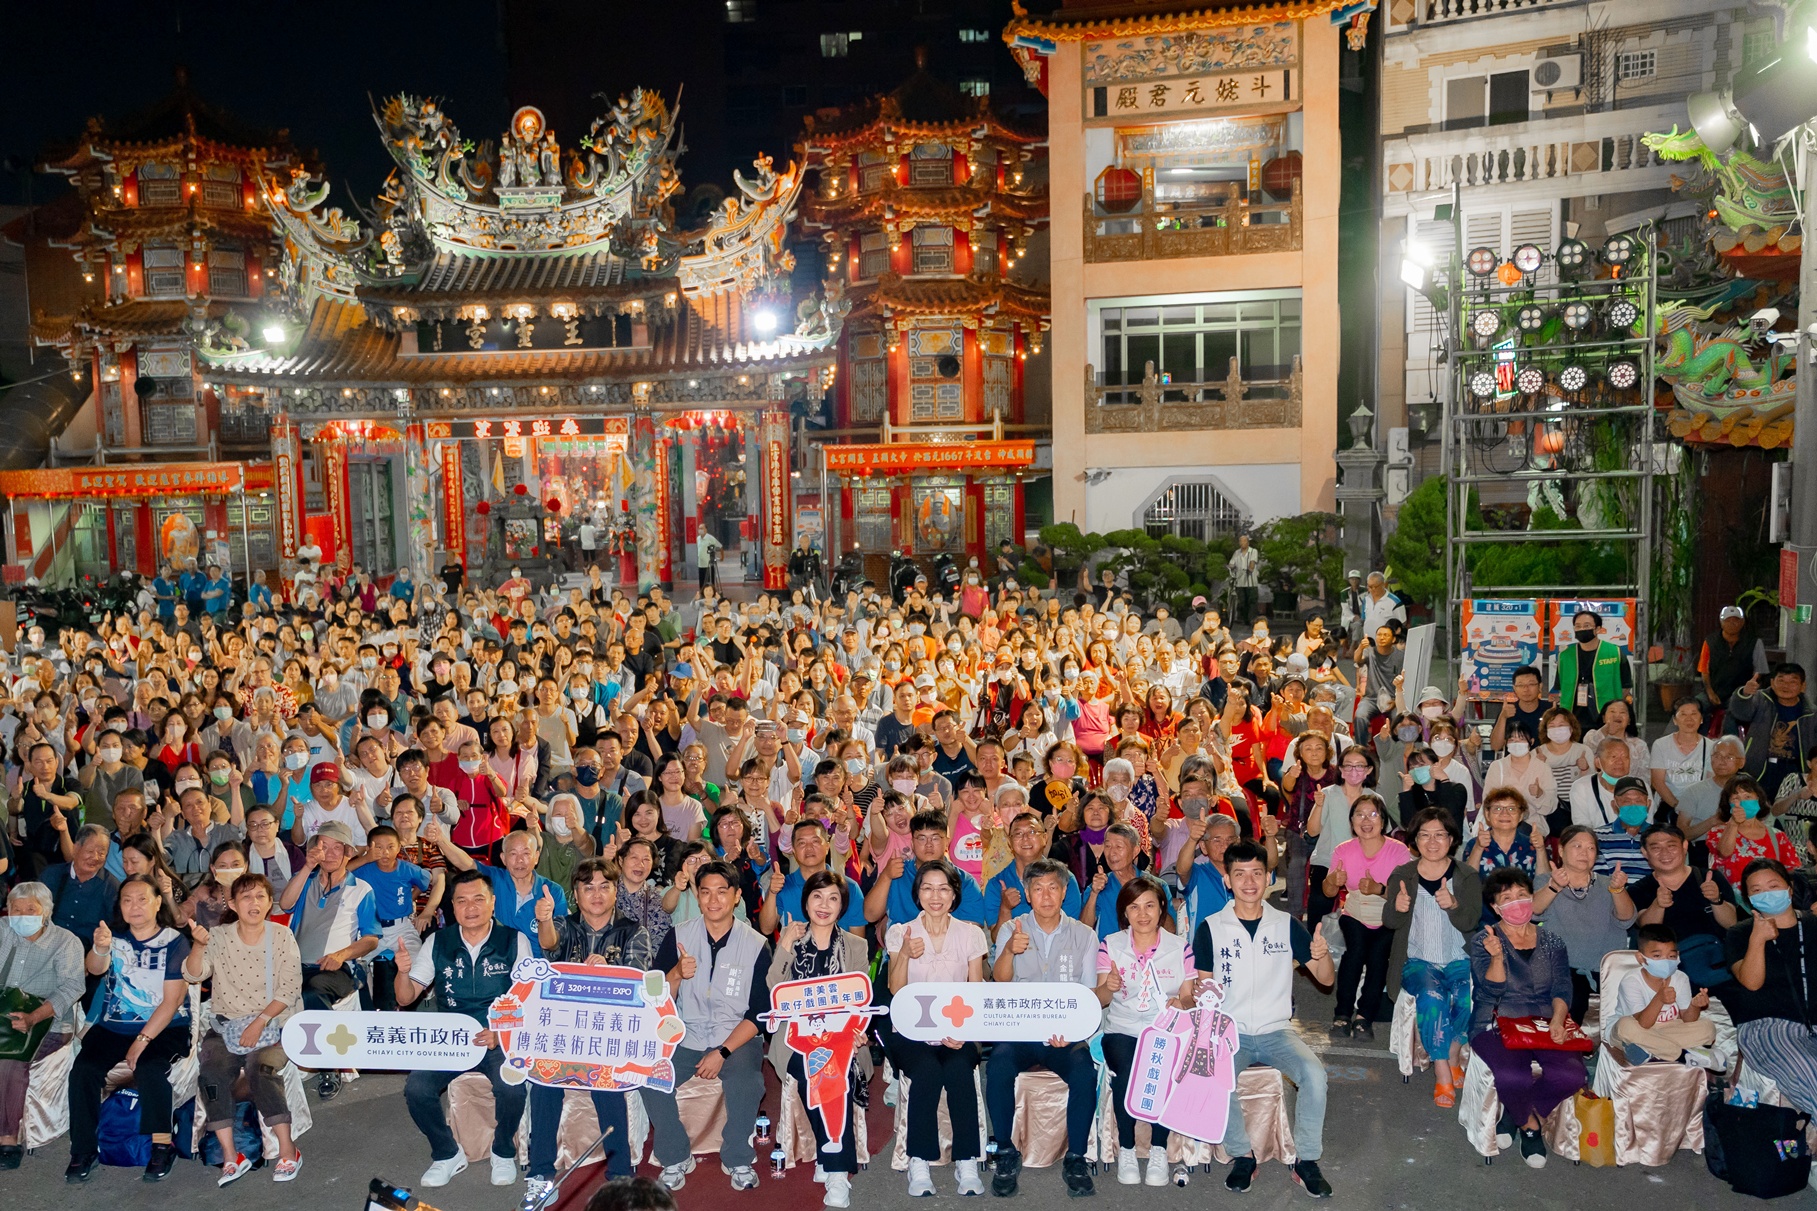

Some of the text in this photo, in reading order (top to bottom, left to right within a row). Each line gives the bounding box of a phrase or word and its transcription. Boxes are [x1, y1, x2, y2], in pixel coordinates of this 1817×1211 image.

[1115, 75, 1272, 110] 斗姥元君殿
[1598, 657, 1618, 666] STAFF
[455, 957, 465, 979] 議員
[612, 988, 632, 996] EXPO
[804, 984, 839, 997] 唐美雲
[780, 991, 865, 1012] 歌仔戲團青年團
[982, 997, 1078, 1010] 嘉義市政府文化局
[538, 1006, 642, 1033] 第二屆嘉義市
[366, 1025, 470, 1046] 嘉義市政府
[516, 1031, 656, 1060] 傳統藝術民間劇場
[416, 1050, 471, 1058] GOVERNMENT
[1140, 1036, 1168, 1112] 勝秋戲劇團
